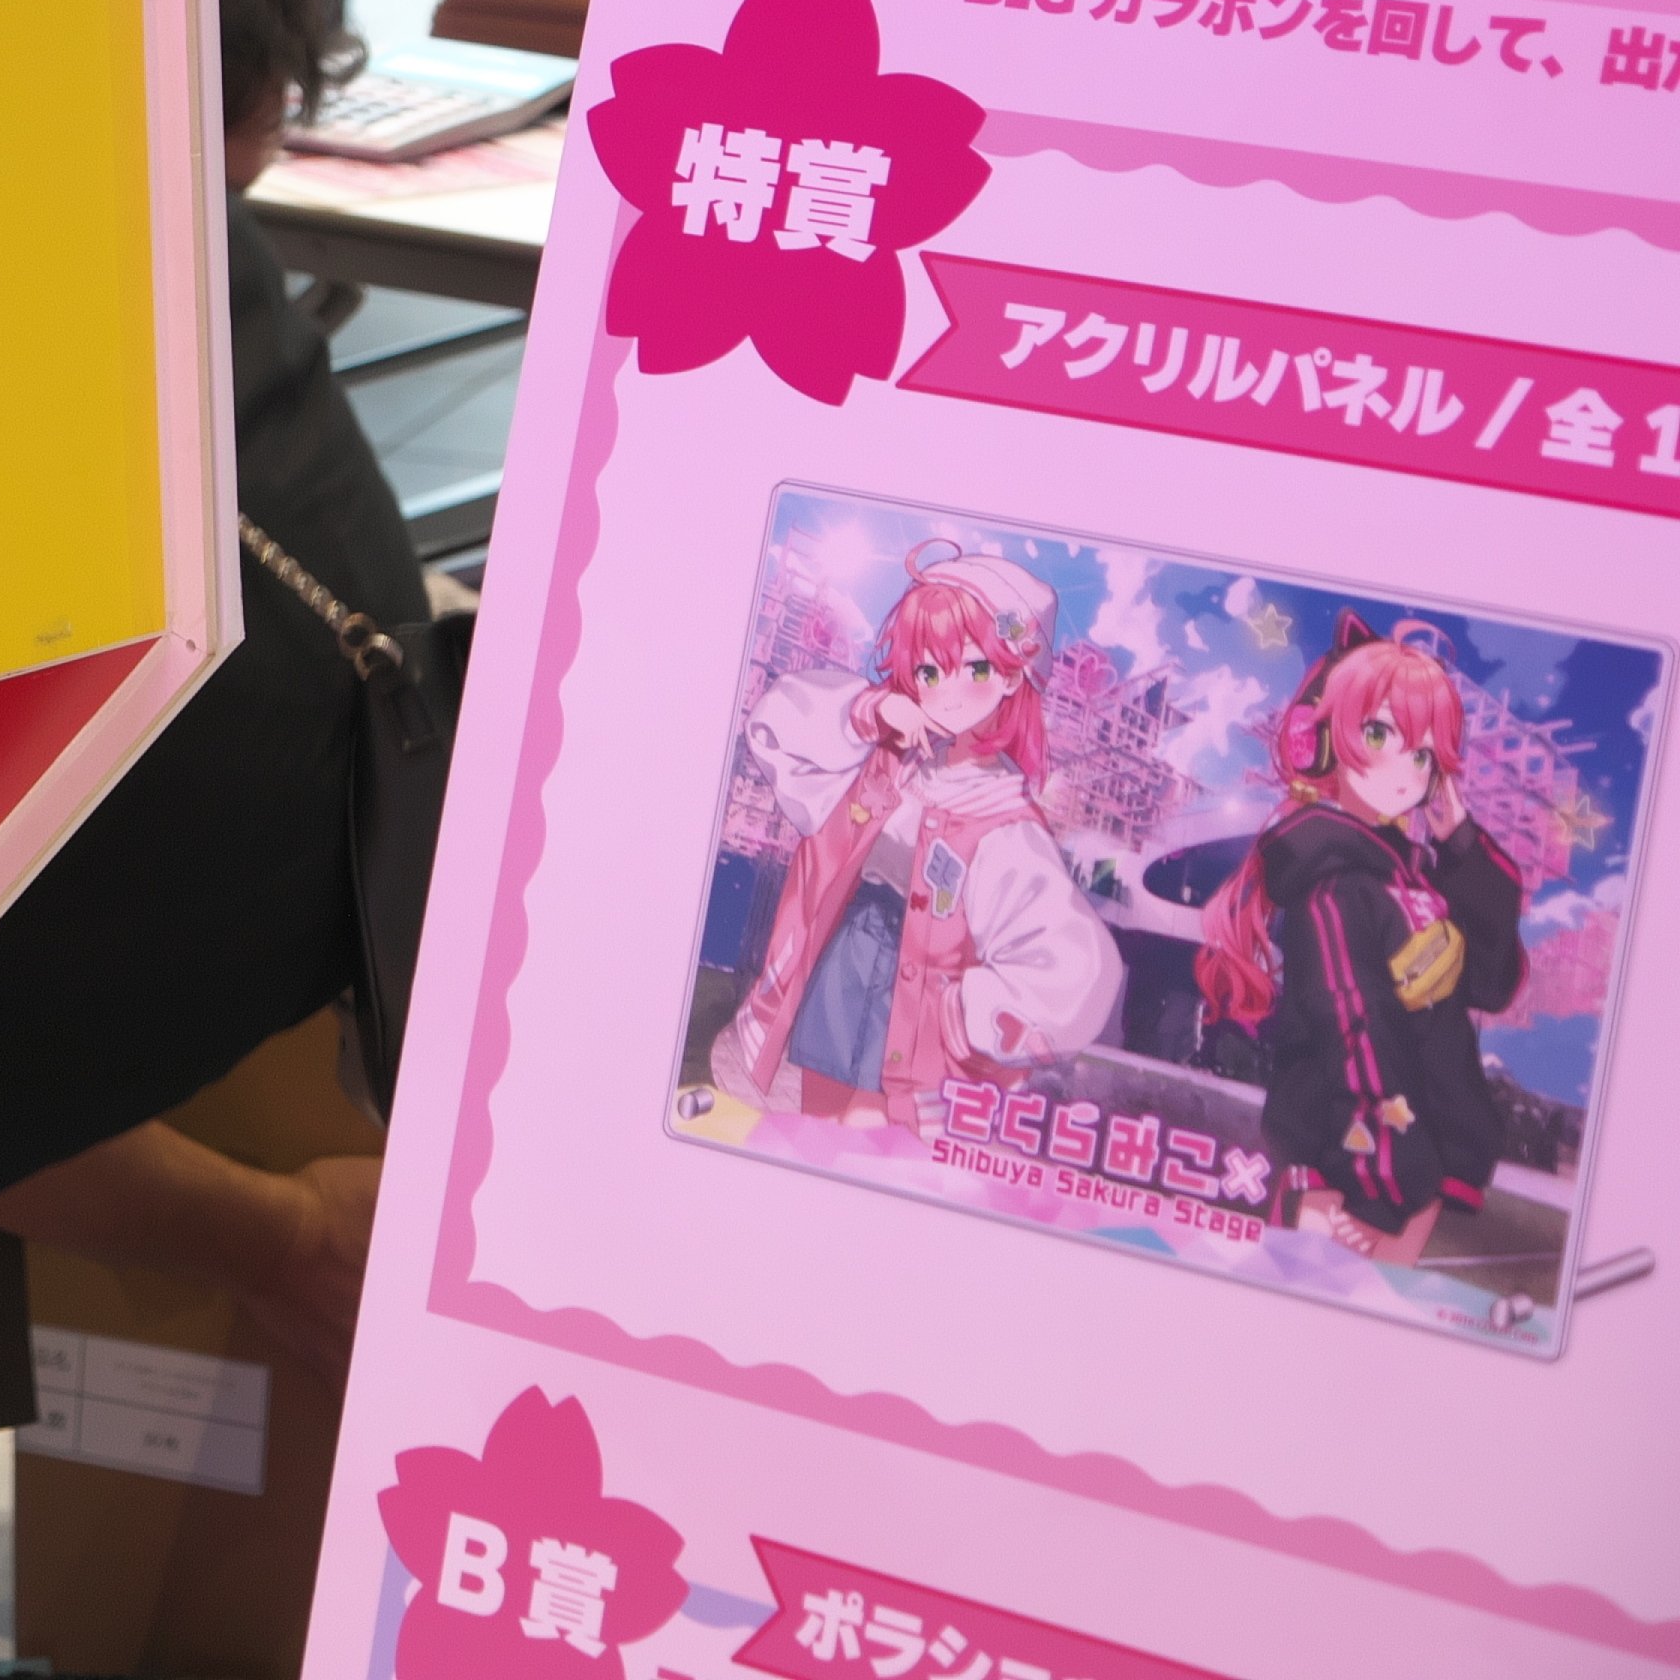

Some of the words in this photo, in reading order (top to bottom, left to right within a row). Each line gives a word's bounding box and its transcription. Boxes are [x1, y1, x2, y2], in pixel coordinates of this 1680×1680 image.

[671, 121, 892, 263] 特賞
[1000, 301, 1465, 436] アクリルパネル
[932, 1138, 1043, 1187] Shibuya
[1056, 1167, 1161, 1217] Sakura
[1173, 1198, 1264, 1243] Stage
[436, 1510, 619, 1660] B賞
